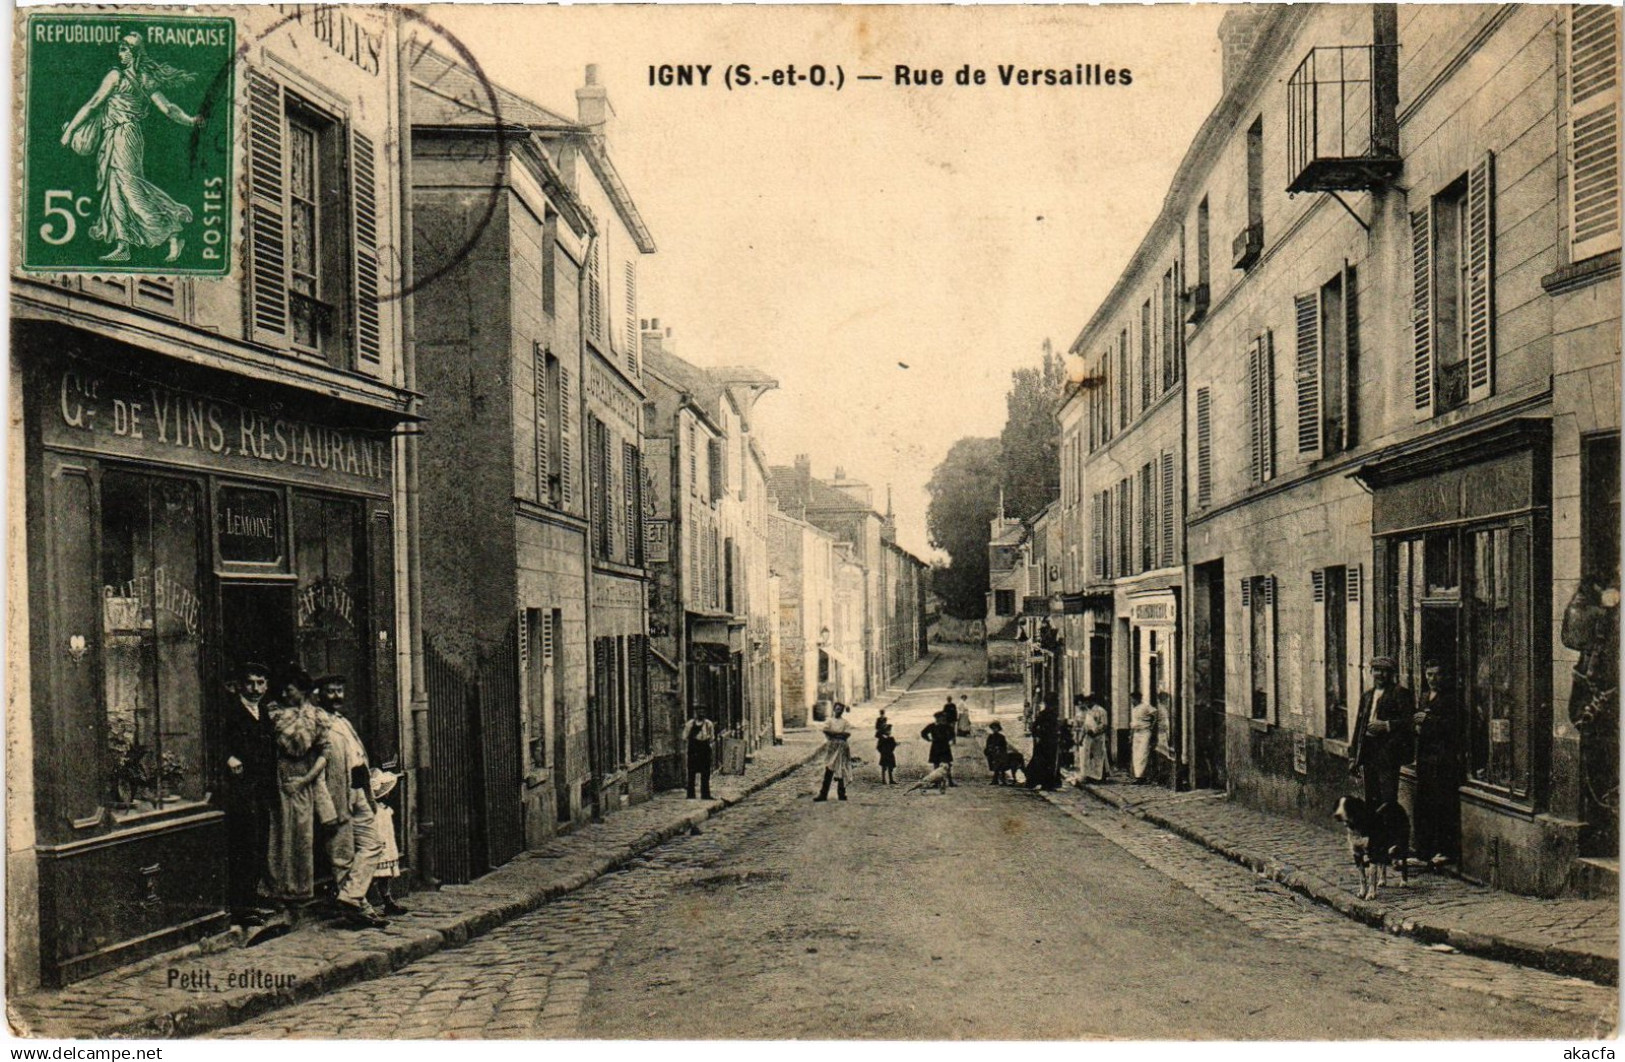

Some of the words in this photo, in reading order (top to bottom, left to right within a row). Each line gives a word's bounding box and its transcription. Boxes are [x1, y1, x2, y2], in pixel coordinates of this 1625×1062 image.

[147, 25, 227, 47] FRANÇAISE
[202, 175, 223, 260] POSTES
[113, 399, 144, 440] DE
[150, 387, 232, 457] VINS,
[238, 403, 386, 480] RESTAURANT
[226, 507, 274, 539] LEMOINE
